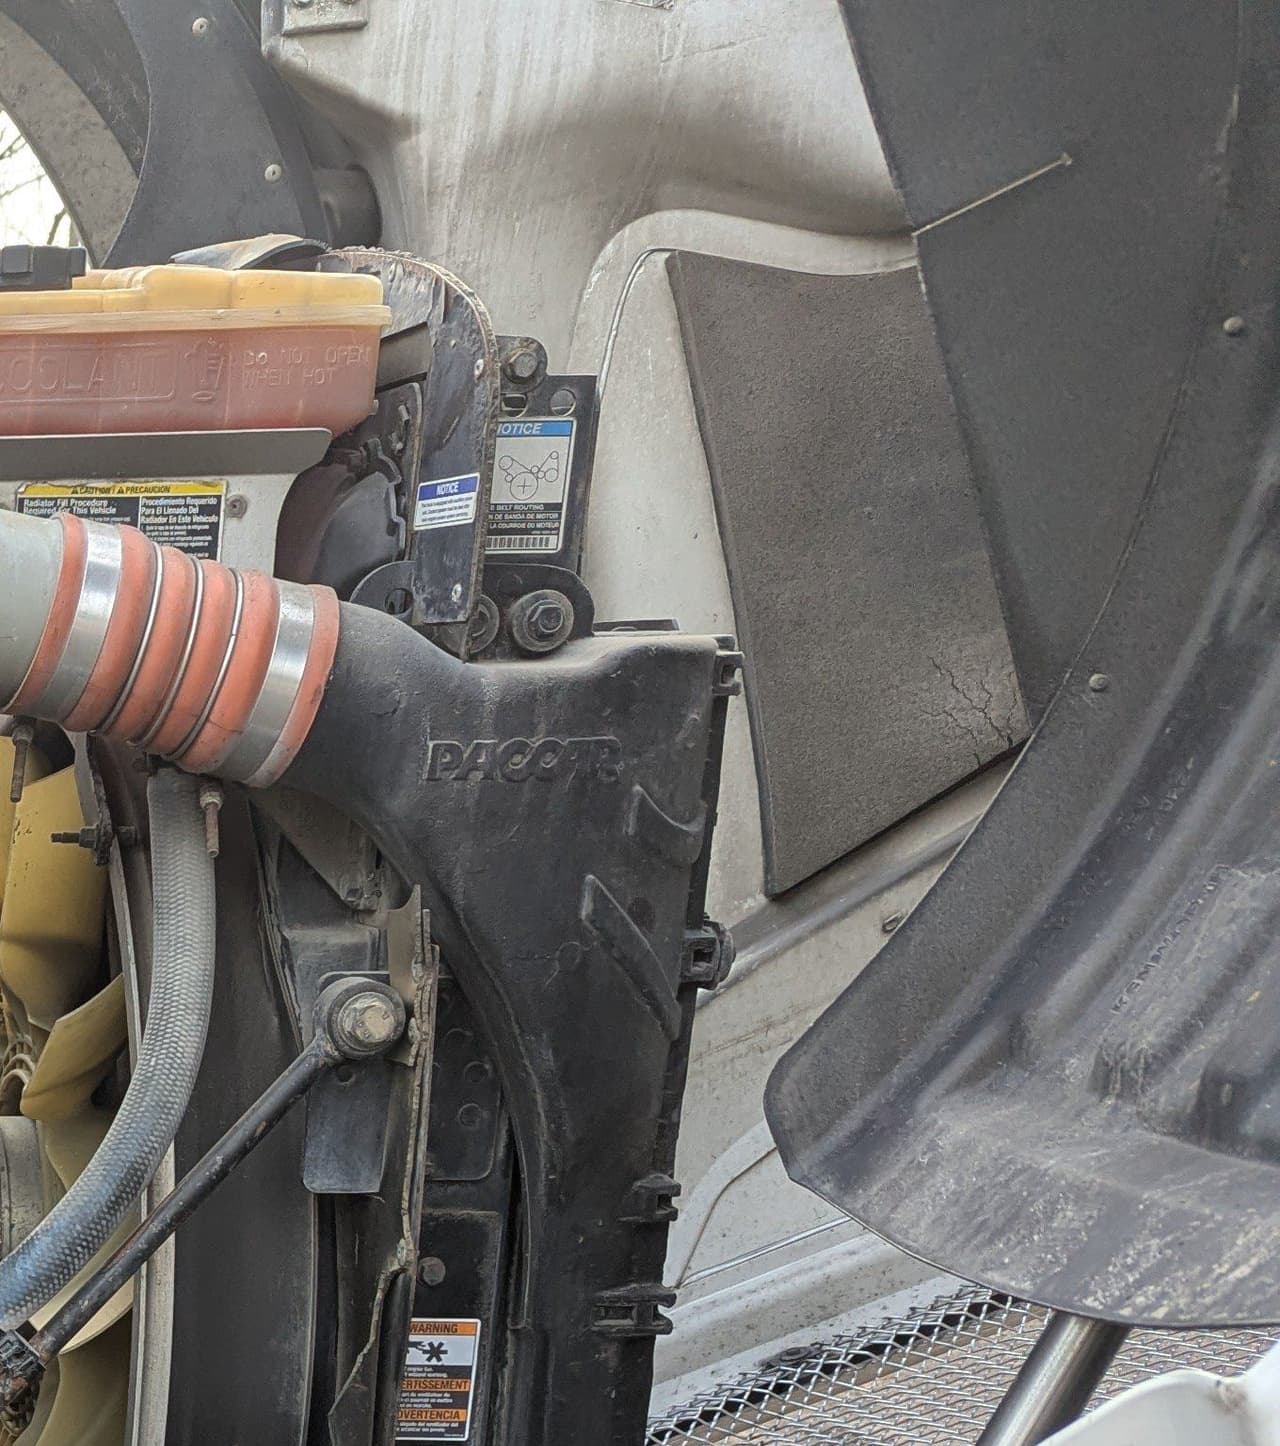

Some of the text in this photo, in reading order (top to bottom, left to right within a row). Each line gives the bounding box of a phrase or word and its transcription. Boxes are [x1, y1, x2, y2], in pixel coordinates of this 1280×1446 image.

[303, 367, 336, 385] HOT
[436, 481, 460, 496] NOTICE
[90, 507, 117, 515] Vehicle
[423, 737, 624, 782] PACCAR
